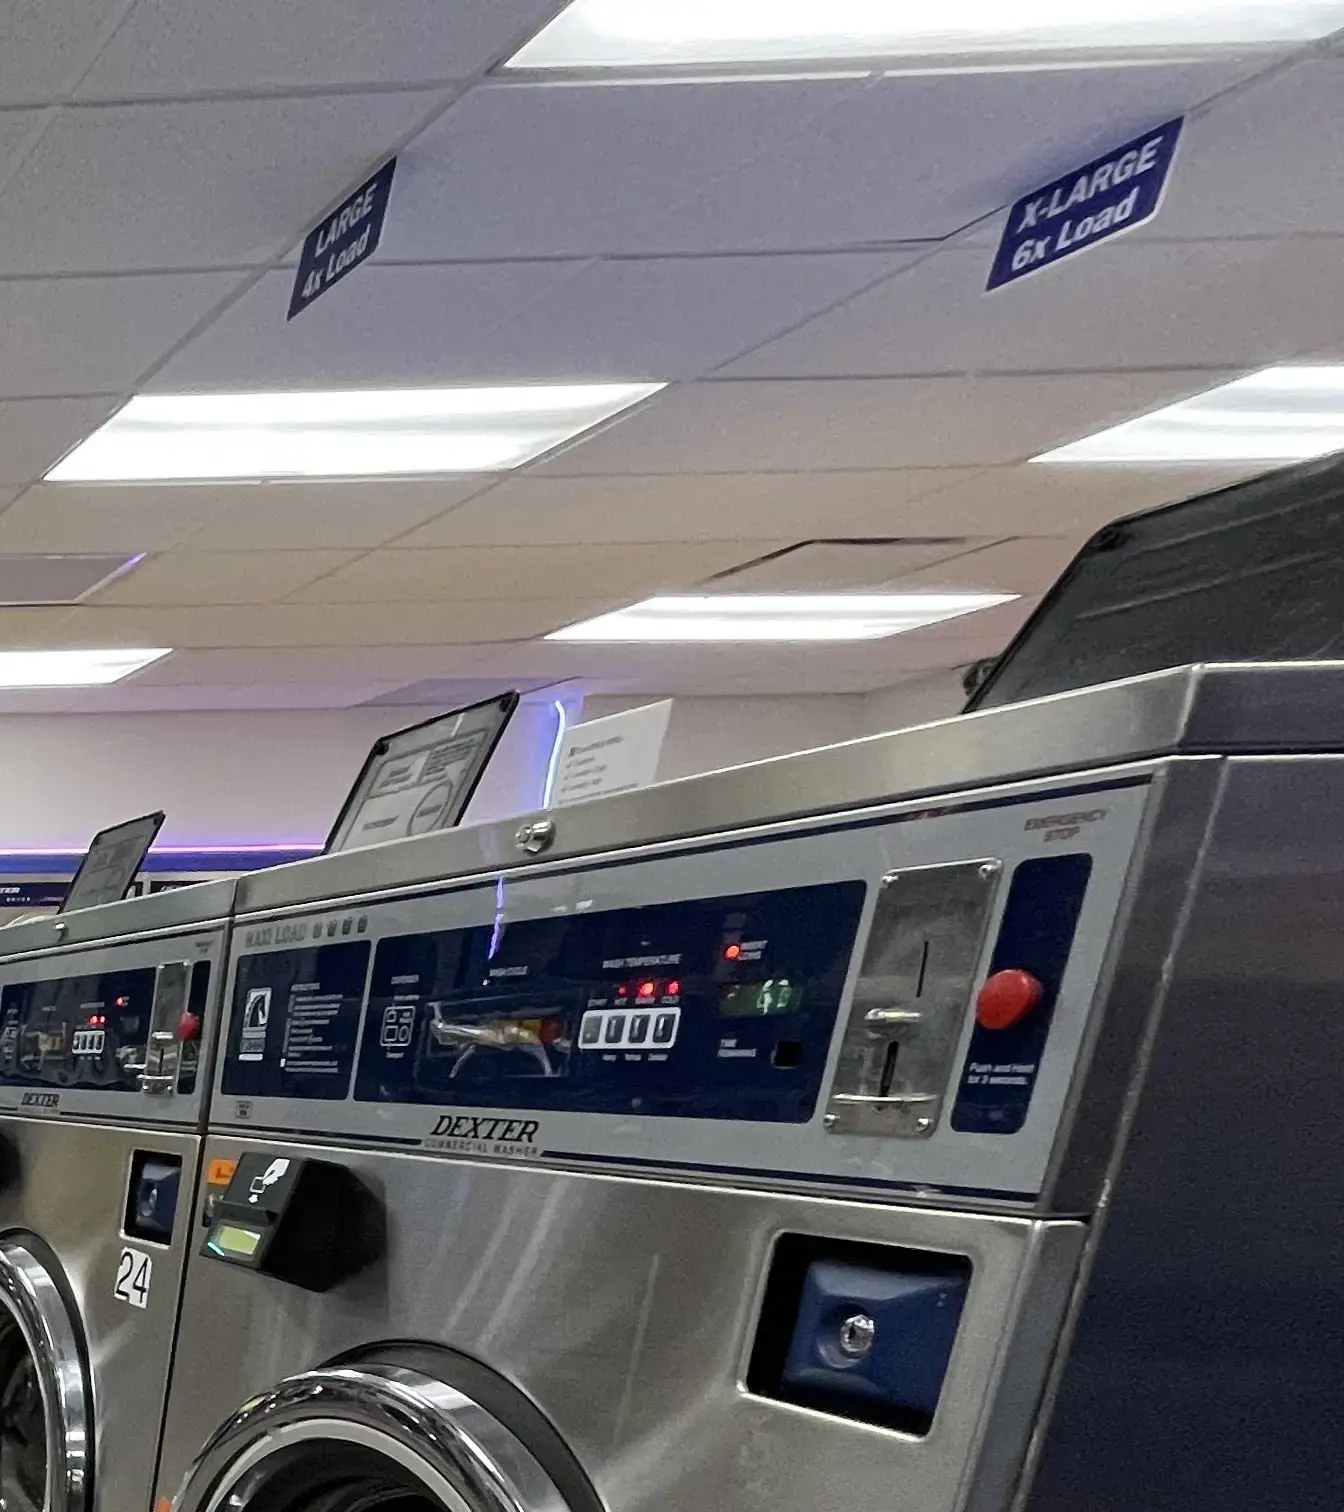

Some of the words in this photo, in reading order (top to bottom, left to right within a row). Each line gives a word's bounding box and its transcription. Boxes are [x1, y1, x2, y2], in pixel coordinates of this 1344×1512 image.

[1017, 134, 1164, 234] X-LARGE
[315, 182, 378, 258] LARGE
[1012, 235, 1052, 271] 6x
[1054, 185, 1140, 251] Load
[325, 222, 372, 283] Load
[1043, 826, 1080, 842] STOP
[423, 1138, 488, 1152] COMMERCIAL
[492, 1144, 539, 1157] WASHER
[430, 1115, 540, 1143] DEXTER
[116, 1251, 149, 1304] 24
